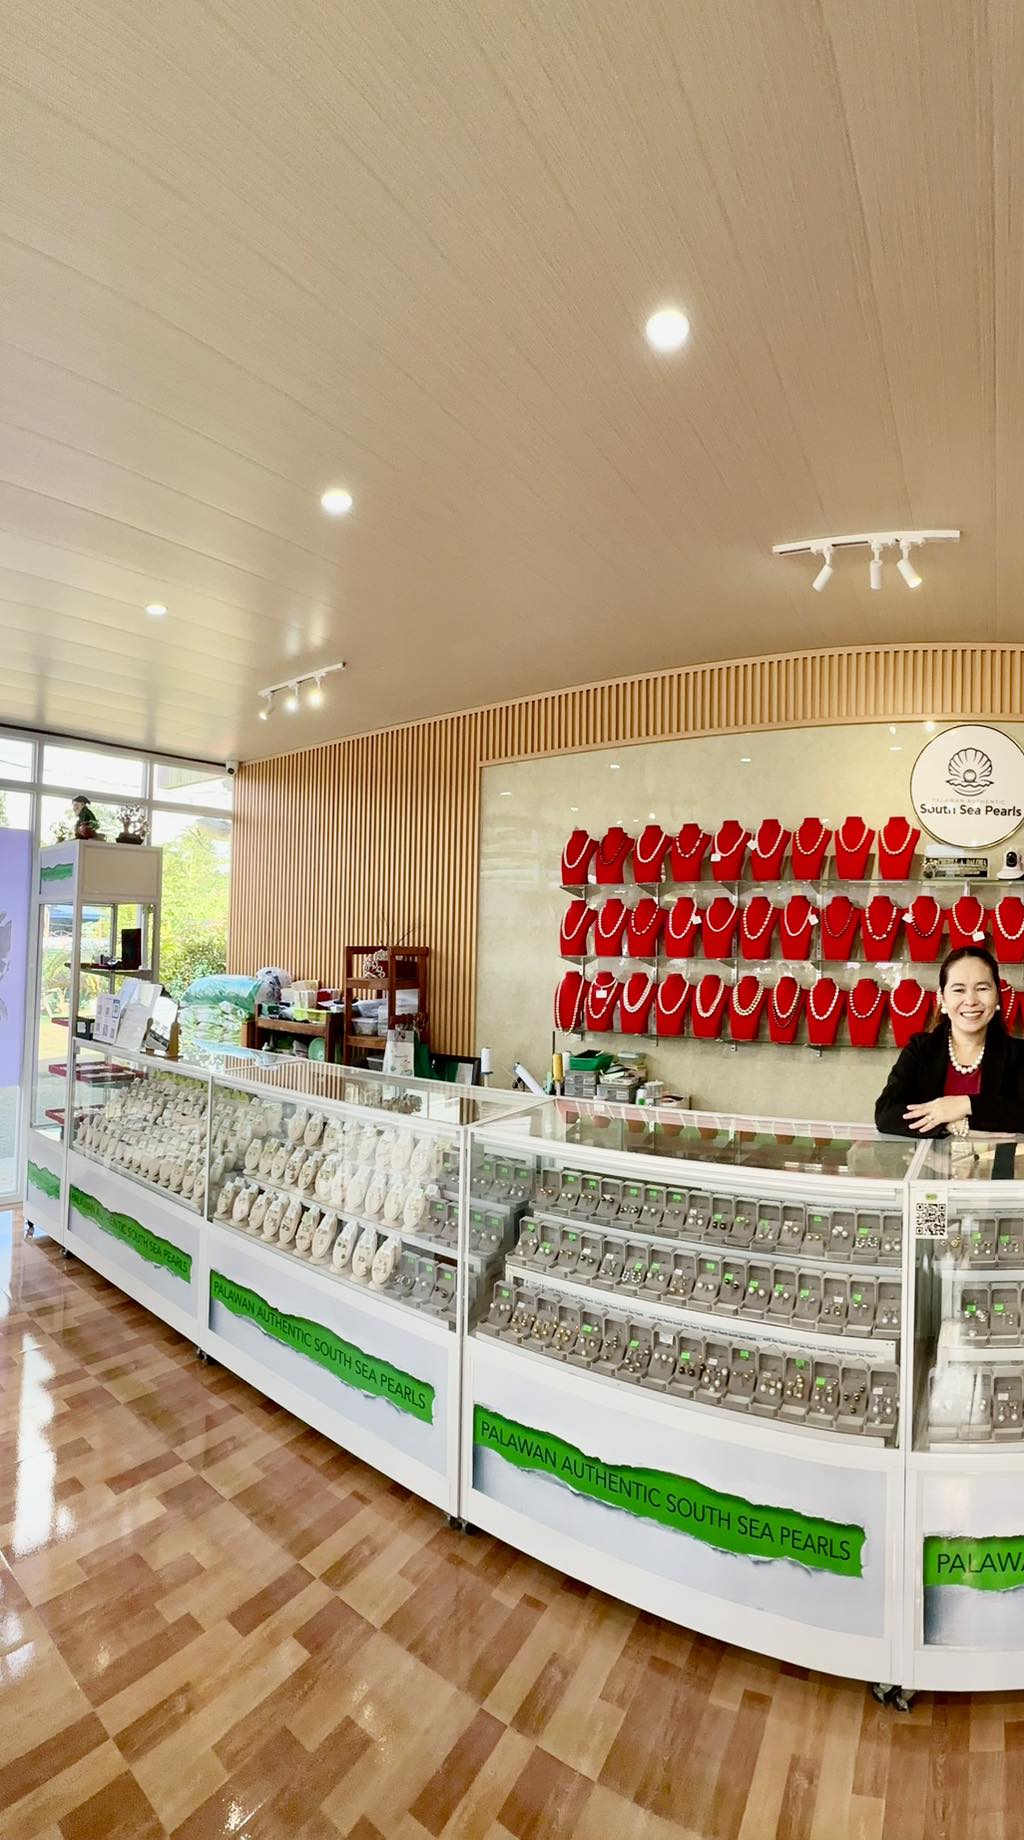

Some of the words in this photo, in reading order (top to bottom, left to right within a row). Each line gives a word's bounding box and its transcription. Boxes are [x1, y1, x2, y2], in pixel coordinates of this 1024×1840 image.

[960, 805, 981, 815] Sea
[985, 805, 1021, 817] Pearls
[127, 1228, 149, 1247] SOUTH
[149, 1240, 162, 1257] SEA
[163, 1249, 188, 1272] PEARLS
[213, 1280, 257, 1316] PALAWAN
[256, 1306, 312, 1348] AUTHENTIC
[314, 1337, 352, 1370] SOUTH
[355, 1359, 377, 1385] SEA
[380, 1373, 426, 1410] PEARLS
[481, 1421, 557, 1468] PALAWAN
[561, 1456, 661, 1508] AUTHENTIC
[666, 1493, 731, 1530] SOUTH
[737, 1516, 774, 1542] SEA
[781, 1527, 850, 1561] PEARLS
